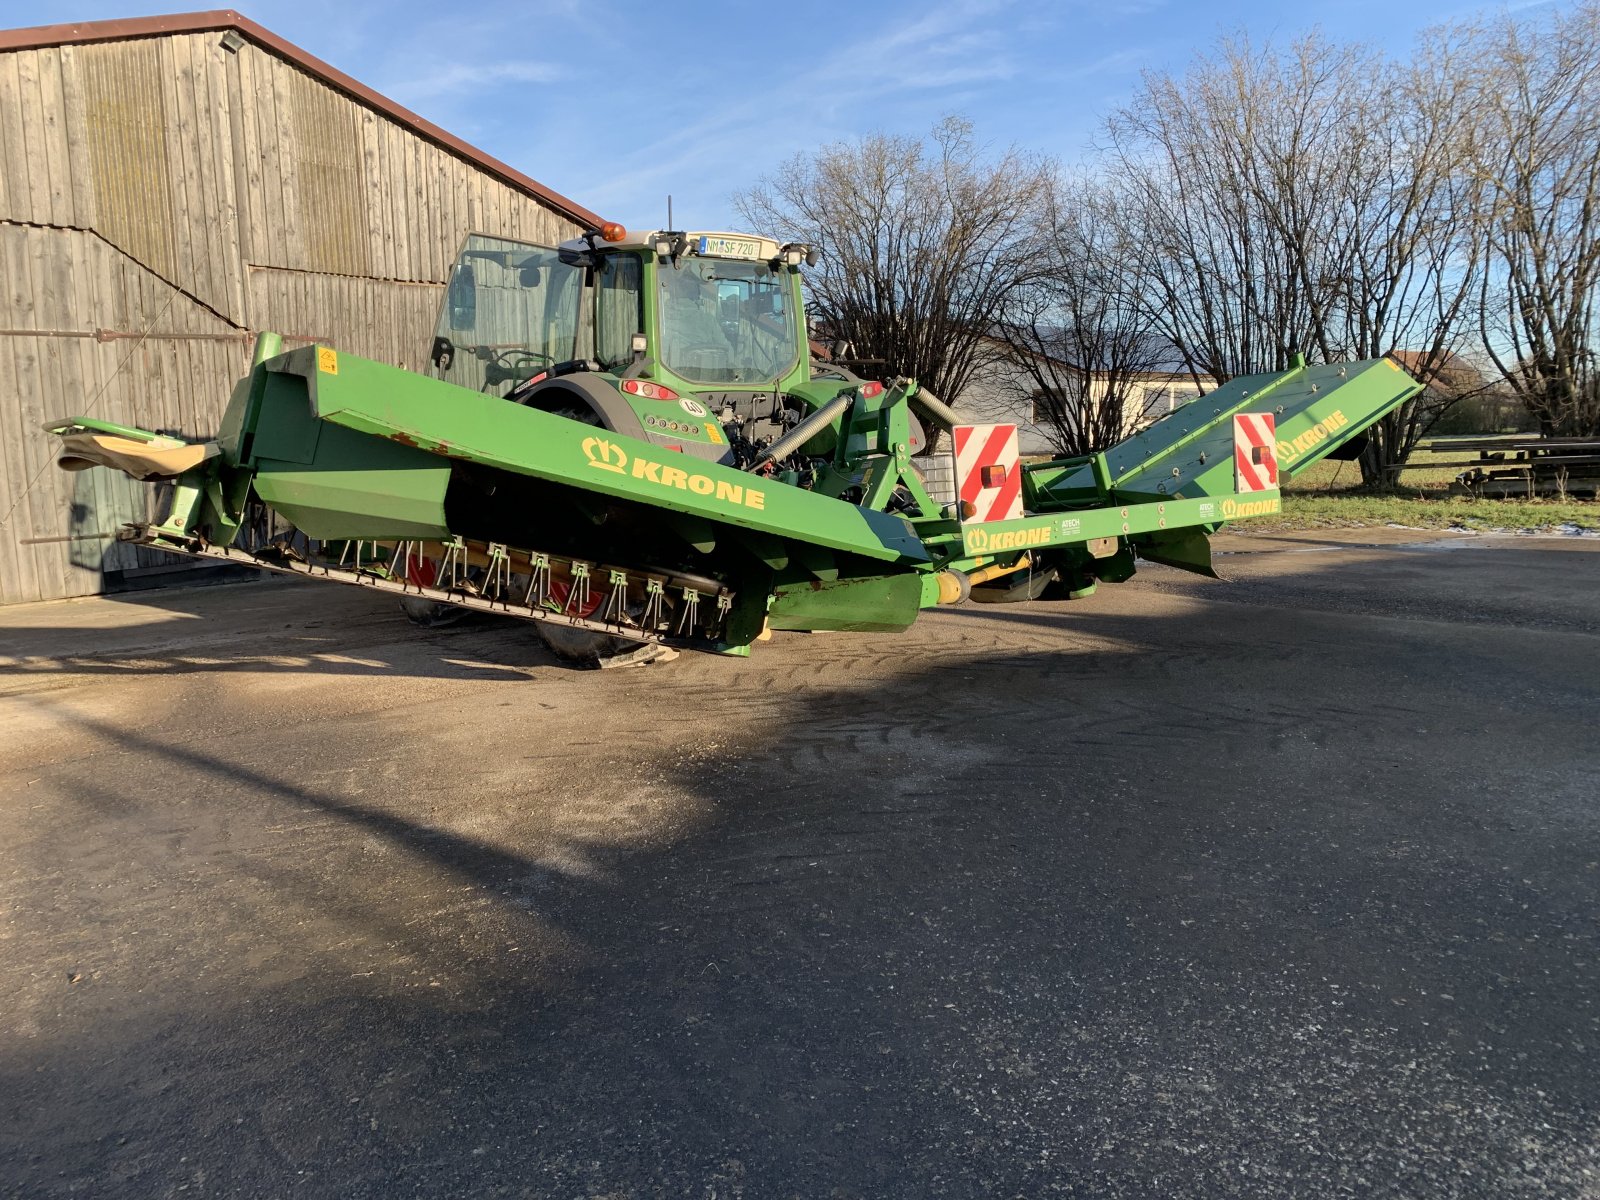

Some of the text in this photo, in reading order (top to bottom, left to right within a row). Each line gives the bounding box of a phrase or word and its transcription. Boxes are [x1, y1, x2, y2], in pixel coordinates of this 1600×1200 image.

[706, 239, 754, 256] NM SF 720
[684, 401, 703, 414] 40
[1292, 409, 1349, 454] KRONE
[631, 457, 765, 511] KRONE
[1236, 498, 1279, 518] KRONE
[1061, 518, 1081, 528] ATECH
[988, 526, 1052, 551] KRONE
